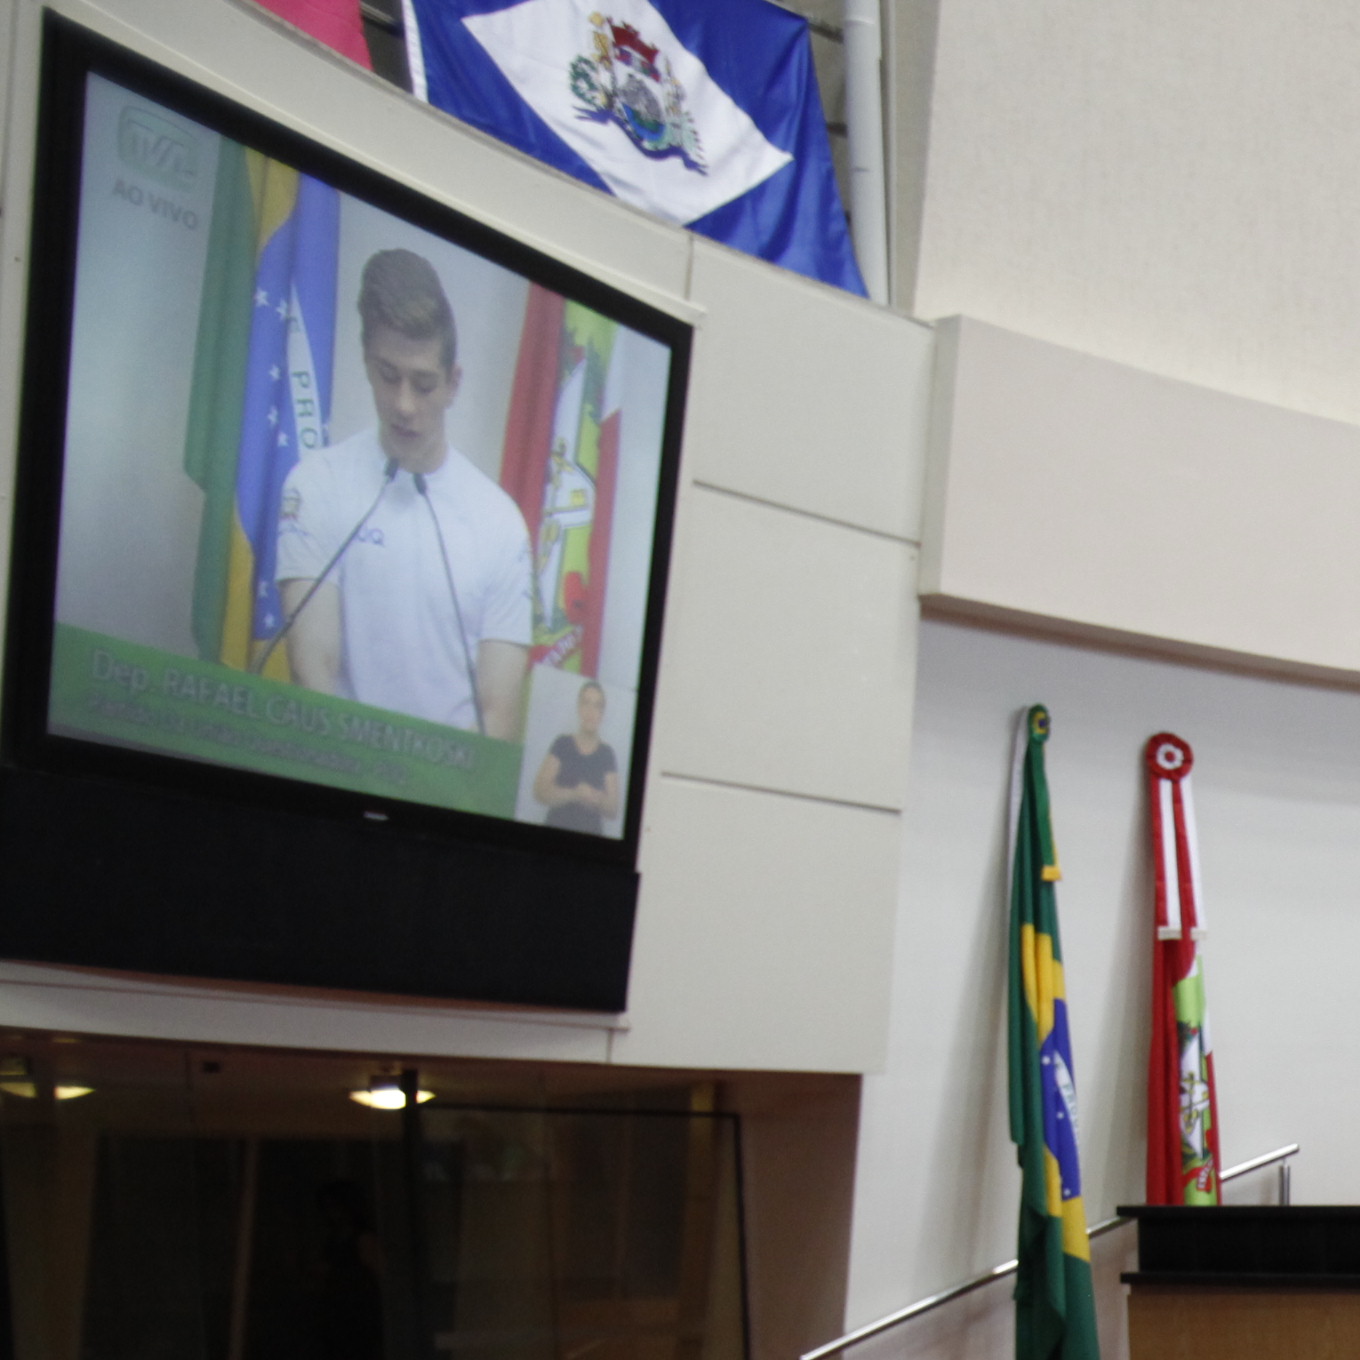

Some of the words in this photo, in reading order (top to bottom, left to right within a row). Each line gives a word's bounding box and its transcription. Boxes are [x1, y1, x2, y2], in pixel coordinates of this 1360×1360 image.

[112, 177, 144, 207] AO
[151, 191, 199, 231] VIVO
[162, 667, 262, 722] RAFAEL
[265, 693, 333, 737] CAUS
